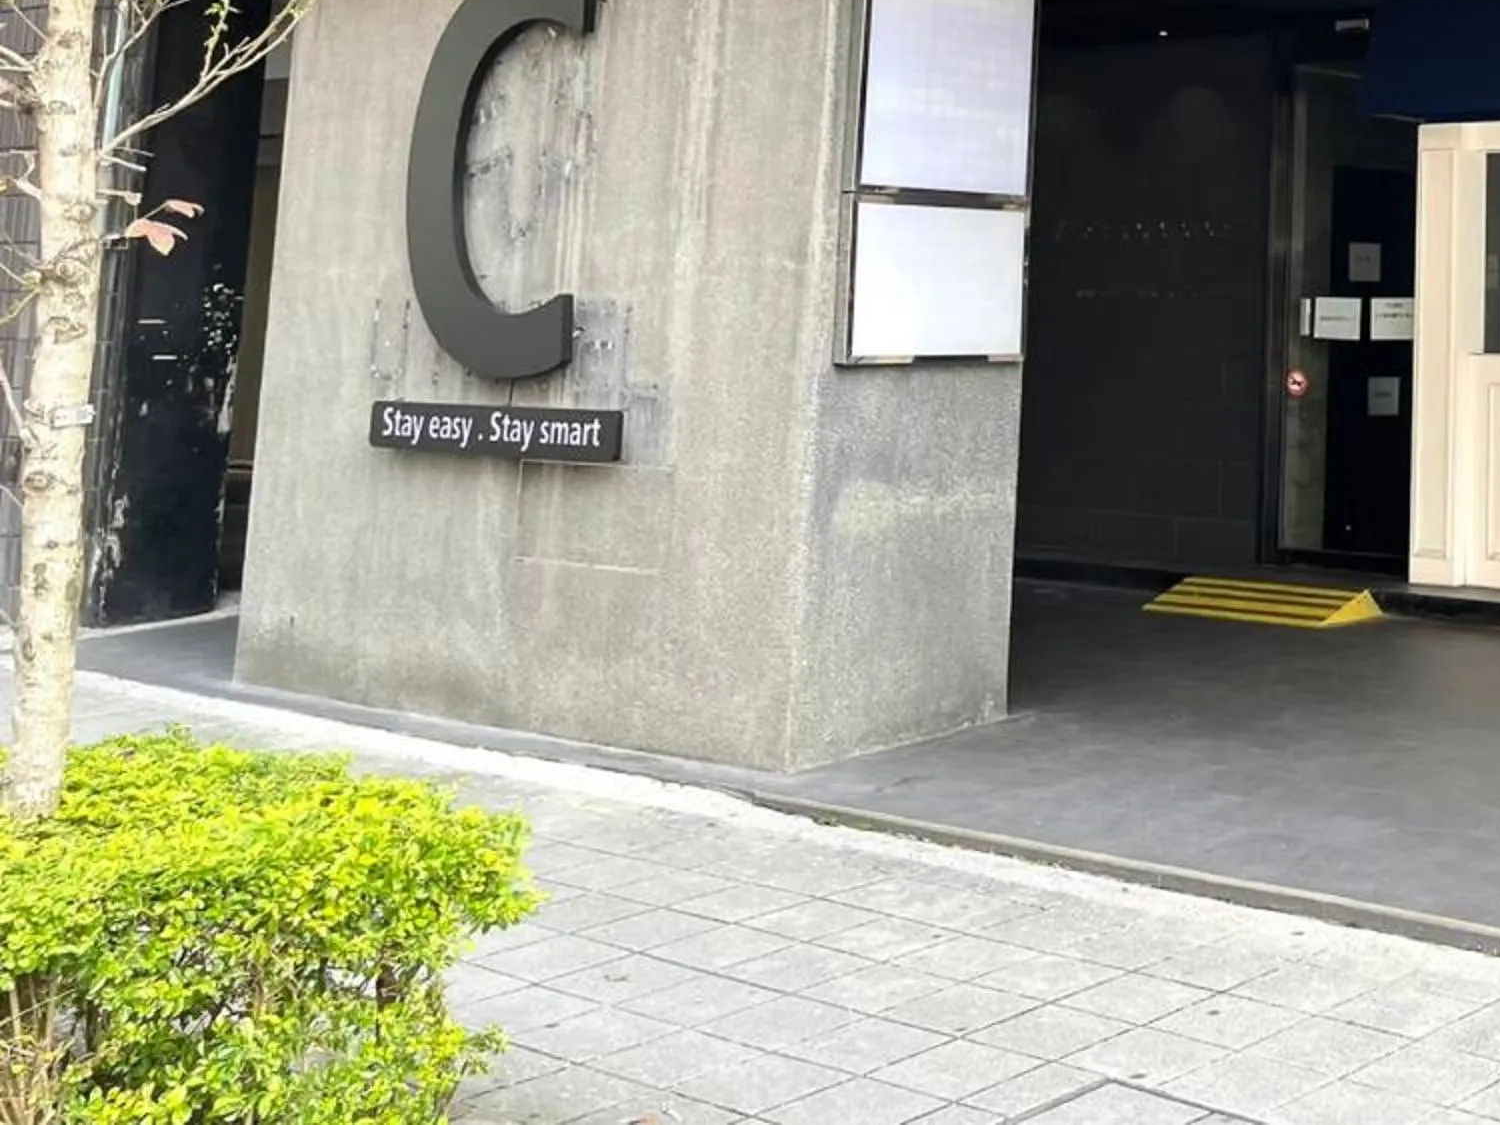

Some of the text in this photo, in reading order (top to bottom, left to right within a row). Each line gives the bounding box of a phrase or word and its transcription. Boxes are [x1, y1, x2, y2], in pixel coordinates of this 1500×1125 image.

[382, 407, 424, 445] Stay
[429, 414, 472, 448] easy
[489, 411, 535, 451] Stay
[540, 418, 601, 446] smart
